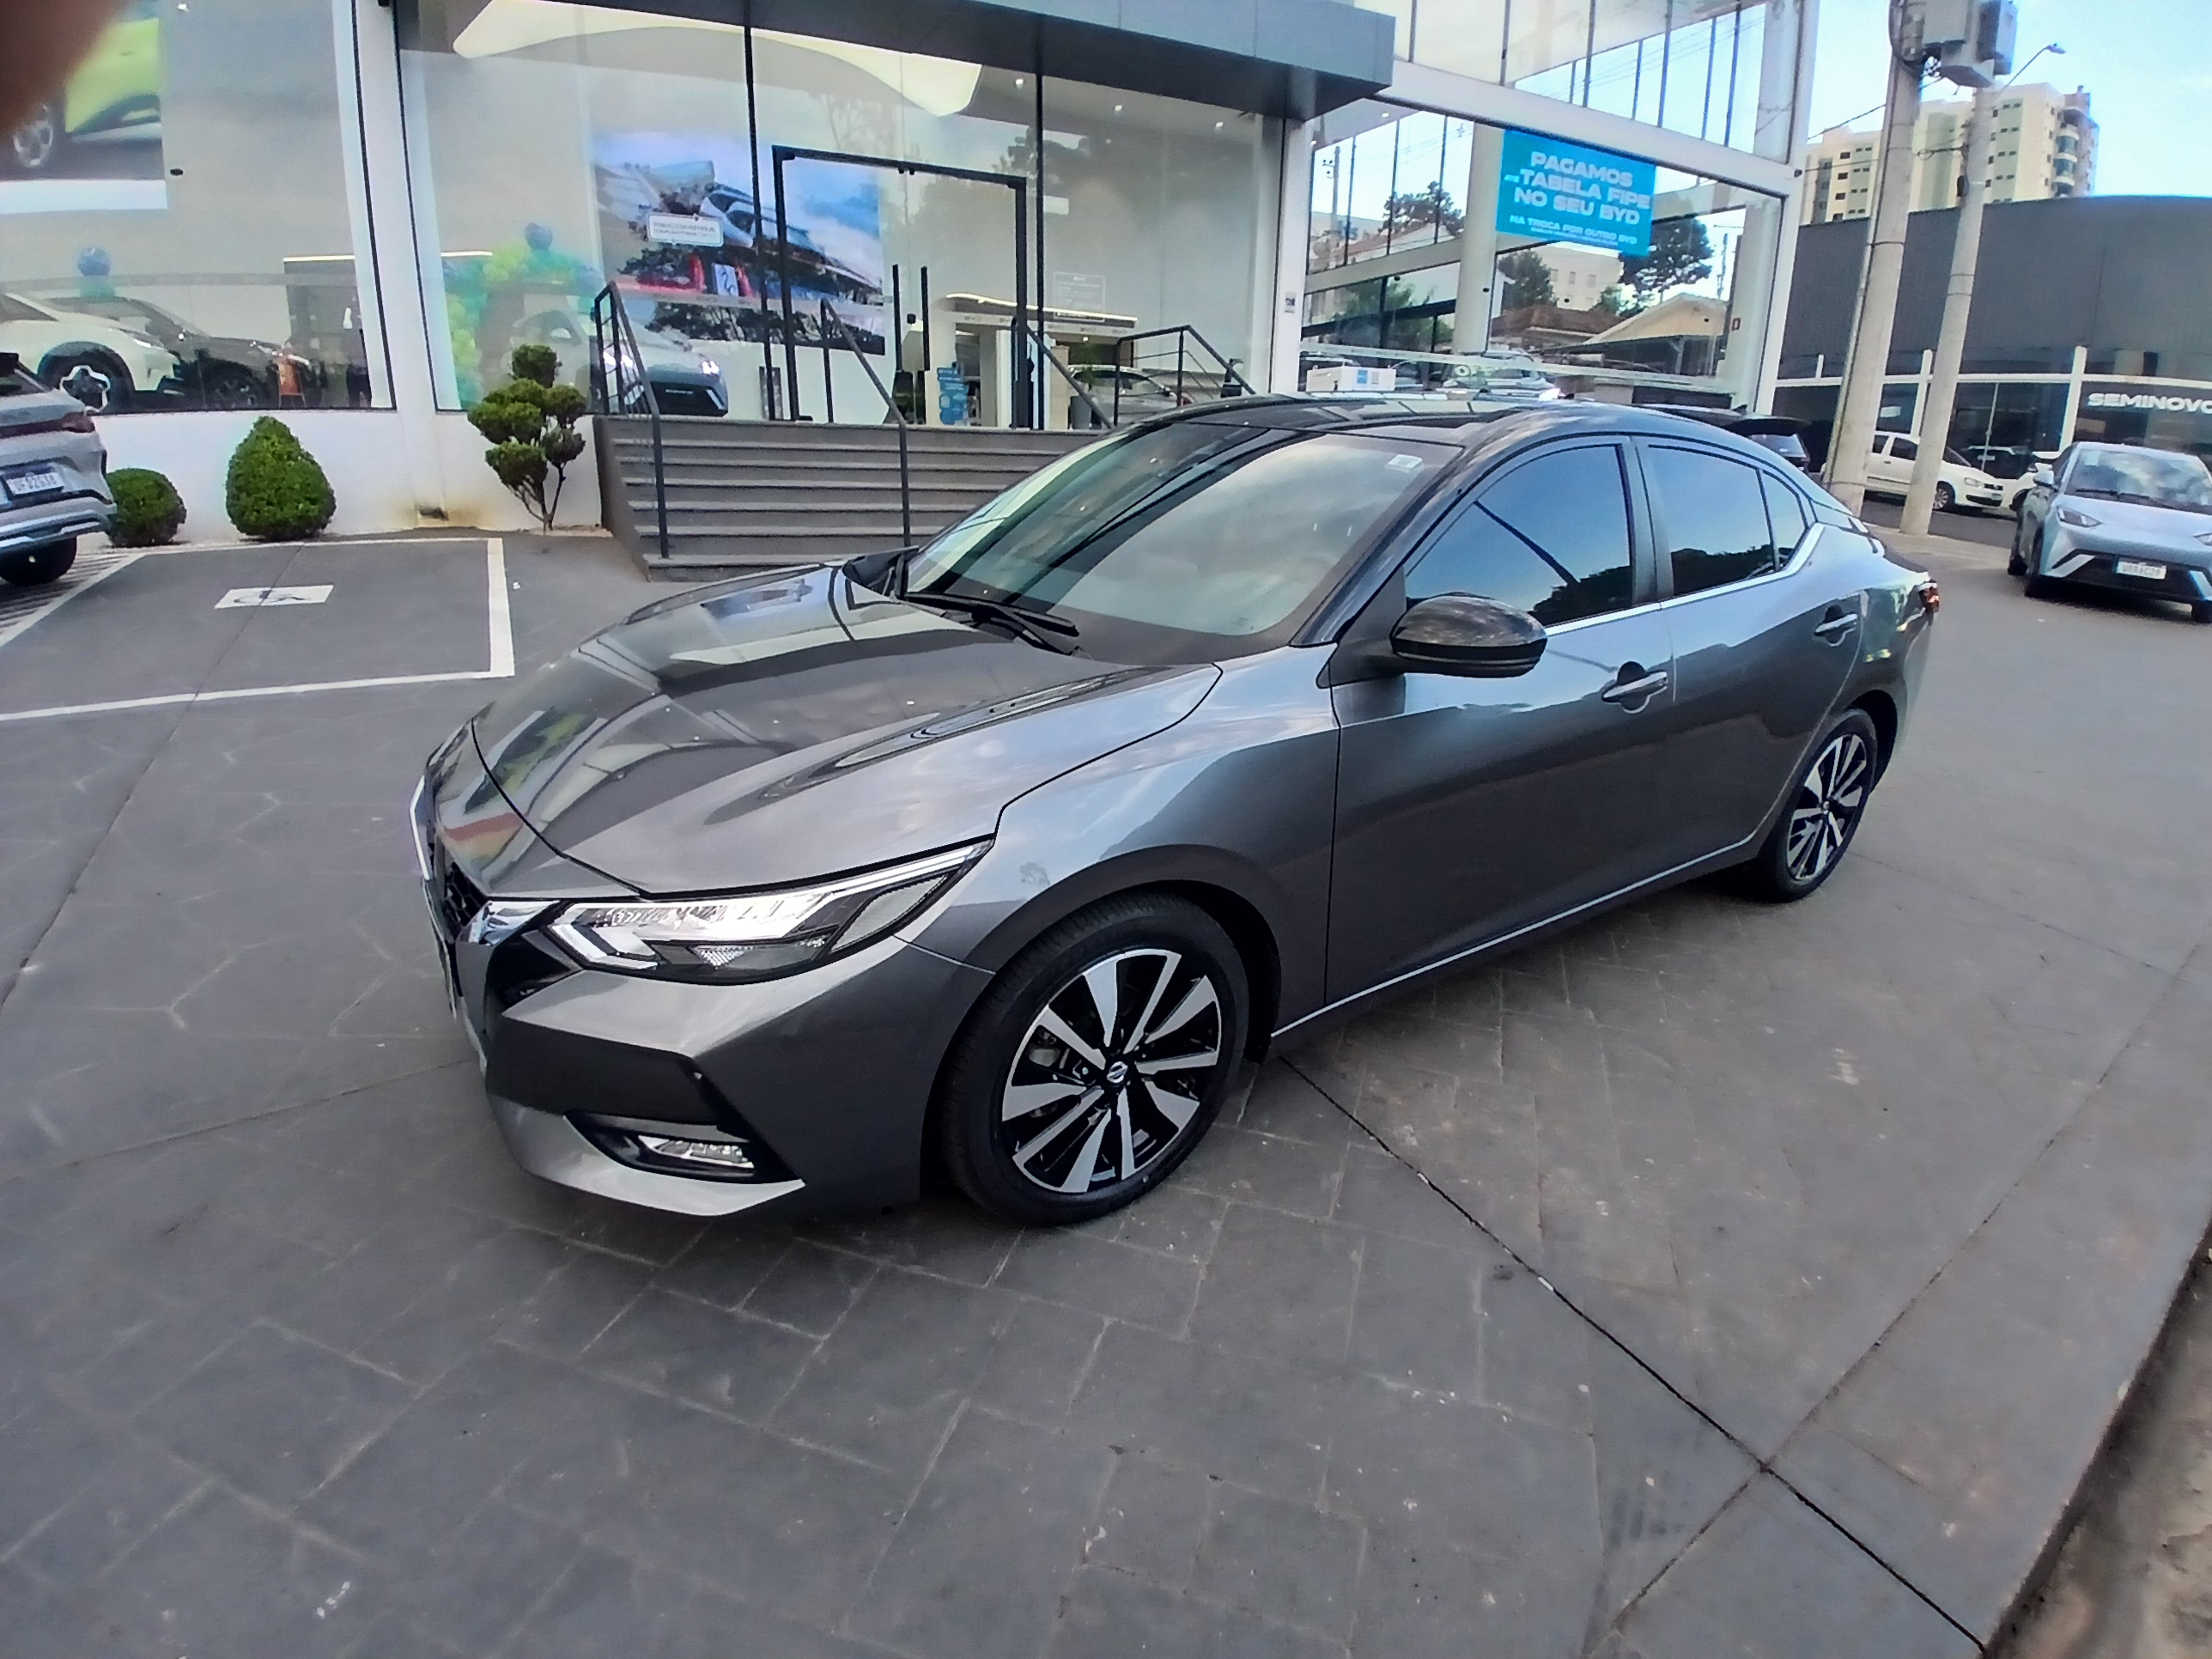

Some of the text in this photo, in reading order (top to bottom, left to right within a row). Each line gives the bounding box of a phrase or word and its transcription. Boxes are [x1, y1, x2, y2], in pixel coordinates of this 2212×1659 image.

[1531, 151, 1632, 187] PAGAMOS
[1514, 187, 1640, 225] NO SEU BYD
[1520, 168, 1601, 200] TABELA
[1607, 186, 1650, 210] FIPE
[1510, 215, 1525, 224] NA
[1528, 217, 1560, 230] TROCA
[1562, 224, 1583, 234] POR
[1584, 228, 1617, 240] OUTRO
[1618, 234, 1638, 244] BYD
